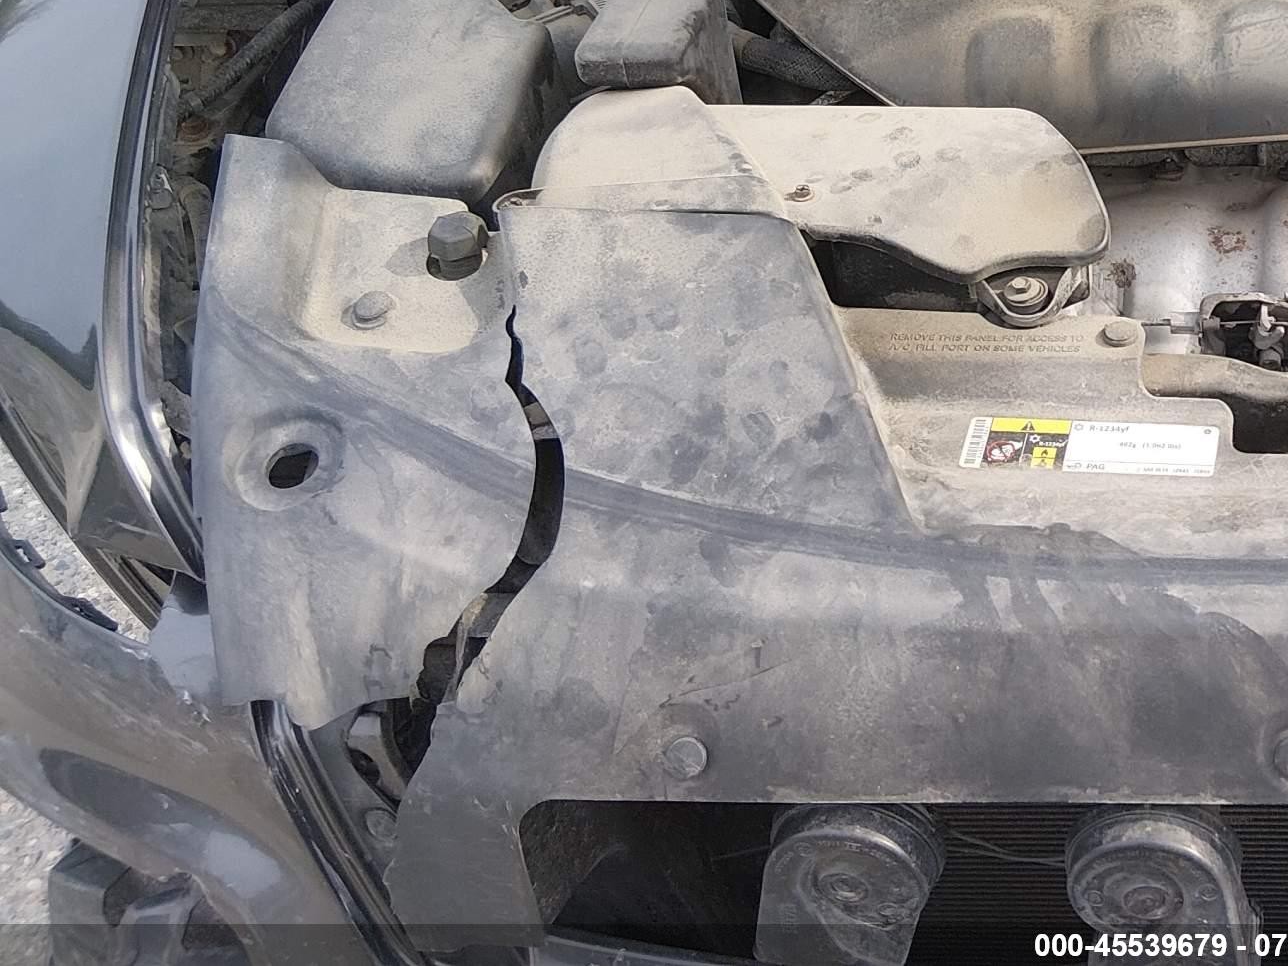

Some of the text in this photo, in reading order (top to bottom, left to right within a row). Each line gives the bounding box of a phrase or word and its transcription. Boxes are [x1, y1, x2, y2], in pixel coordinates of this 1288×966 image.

[890, 333, 1084, 343] REMOVE THIS PANEL FOR ACCESS TO
[888, 343, 1080, 353] A/C FILL PORT ON SOME VEHICLES
[1086, 462, 1105, 471] PAG
